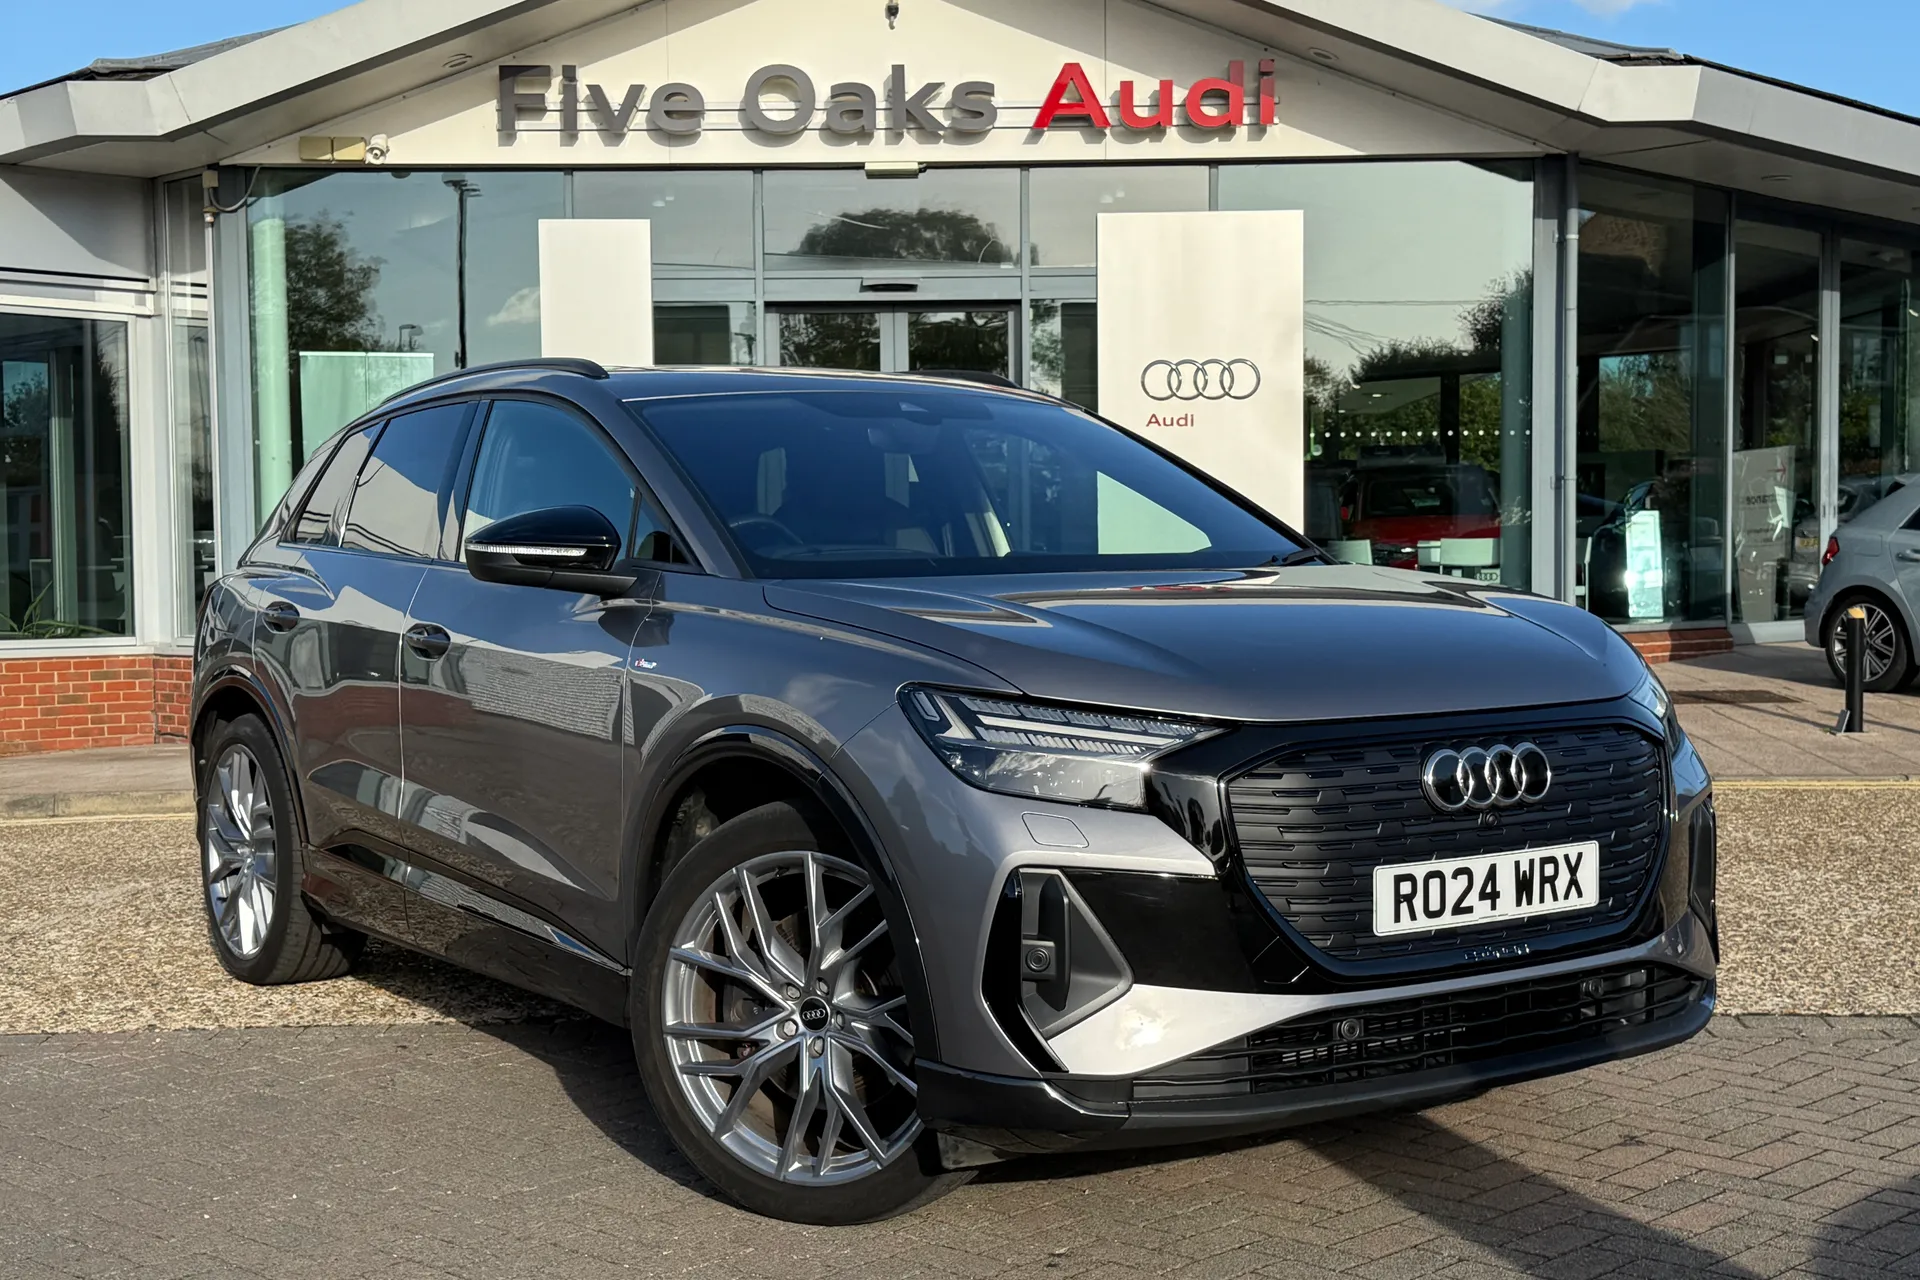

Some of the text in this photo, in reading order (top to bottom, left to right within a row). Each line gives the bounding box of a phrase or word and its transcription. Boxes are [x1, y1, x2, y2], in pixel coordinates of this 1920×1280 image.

[499, 59, 1275, 134] Five Oaks Audi
[1146, 413, 1194, 427] Audi
[1393, 852, 1583, 923] RO24 WRX
